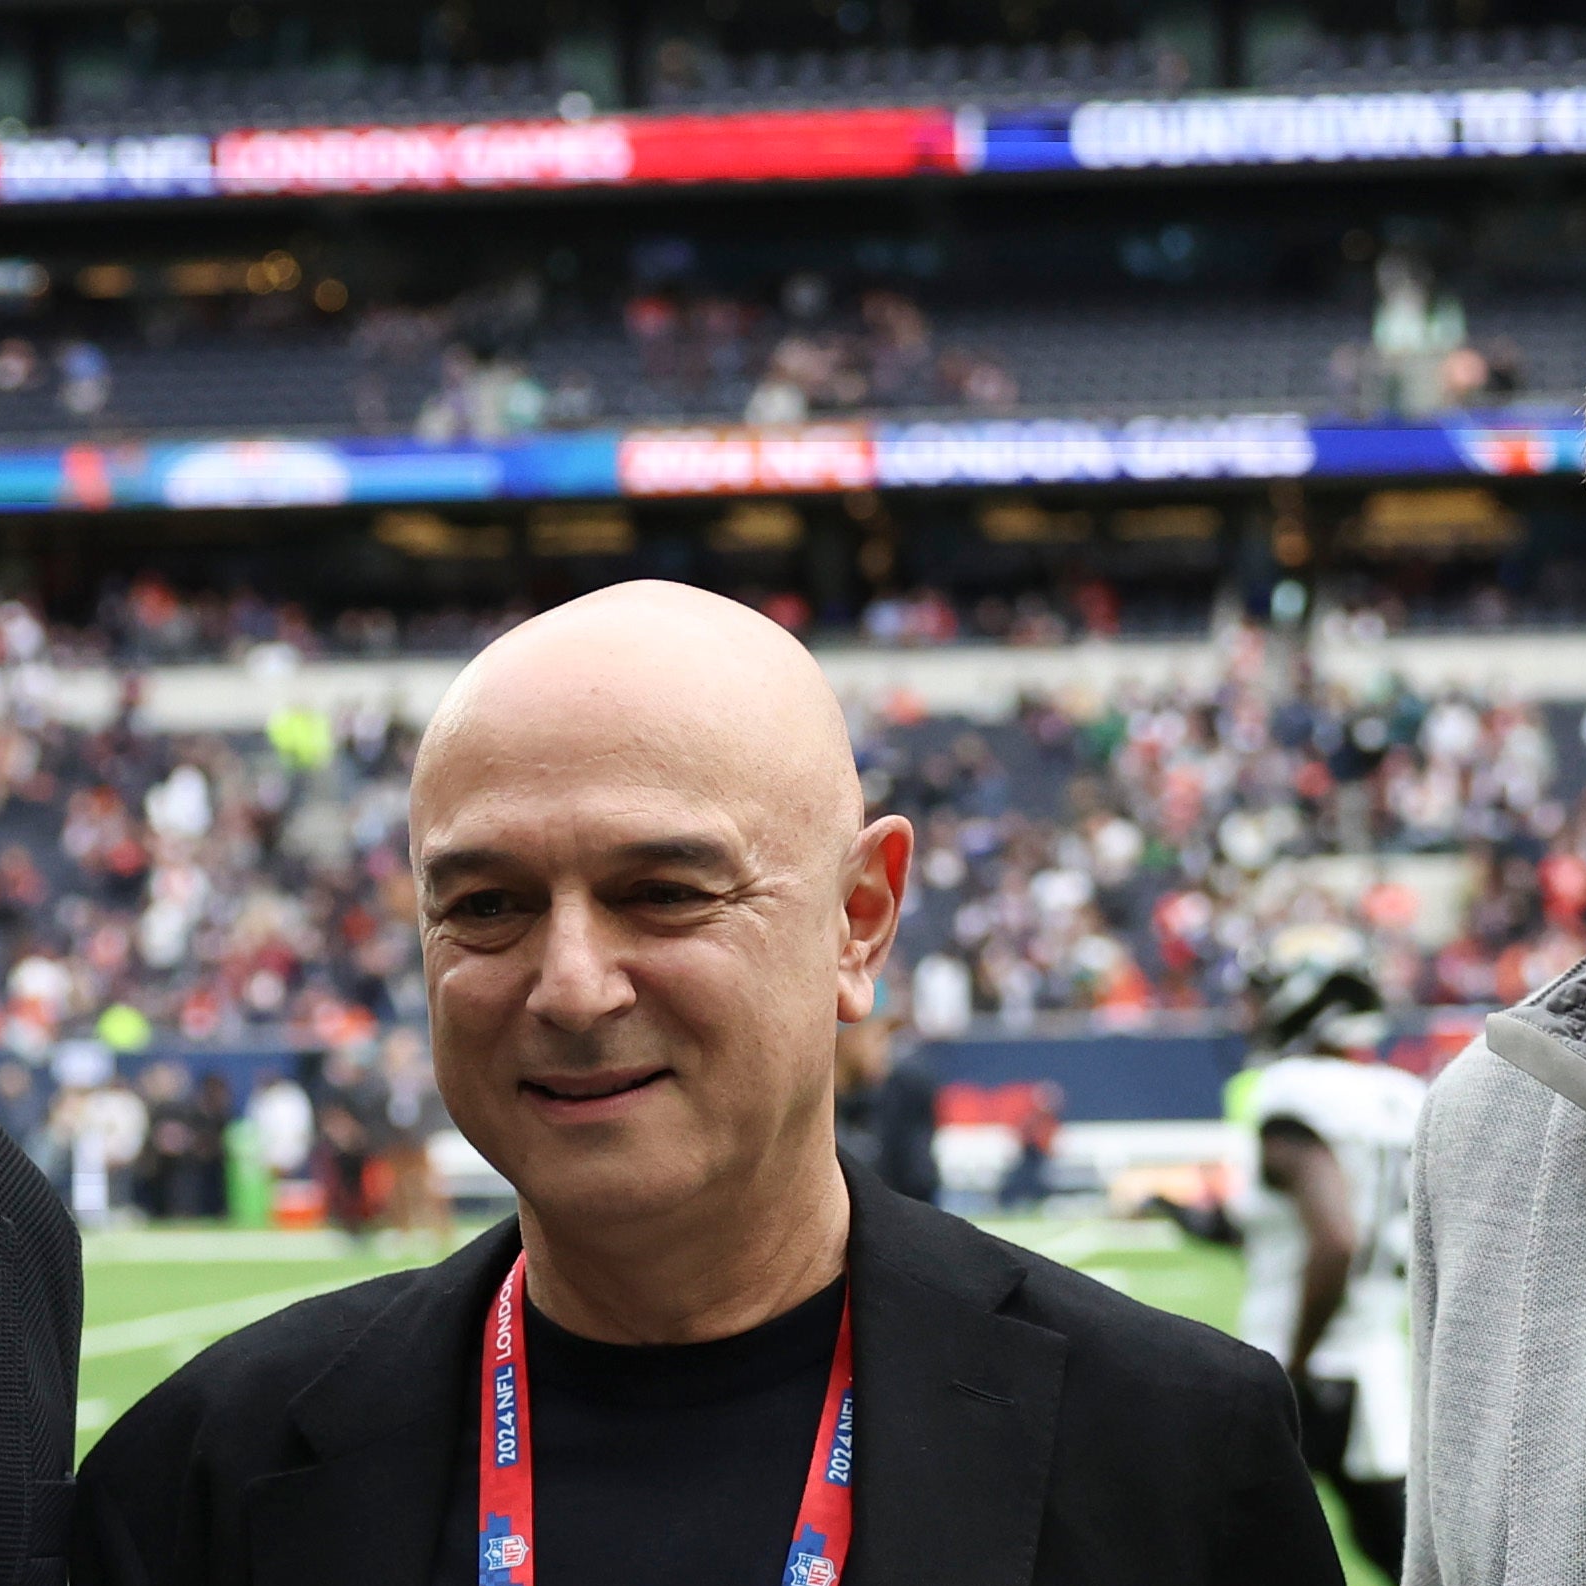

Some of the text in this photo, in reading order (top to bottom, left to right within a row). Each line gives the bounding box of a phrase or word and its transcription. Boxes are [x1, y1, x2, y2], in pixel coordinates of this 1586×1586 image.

[1071, 93, 1451, 168] COUNTDOWN
[1459, 88, 1534, 158] TO
[220, 129, 439, 194] LONDON
[455, 124, 633, 187] GAMES
[879, 421, 1113, 485] LONDON
[1121, 417, 1311, 479] GAMES
[496, 1366, 513, 1410] NFL
[497, 1411, 516, 1464] 2024
[828, 1434, 853, 1482] 2024
[502, 1537, 519, 1562] NFL
[808, 1562, 830, 1586] NFL
